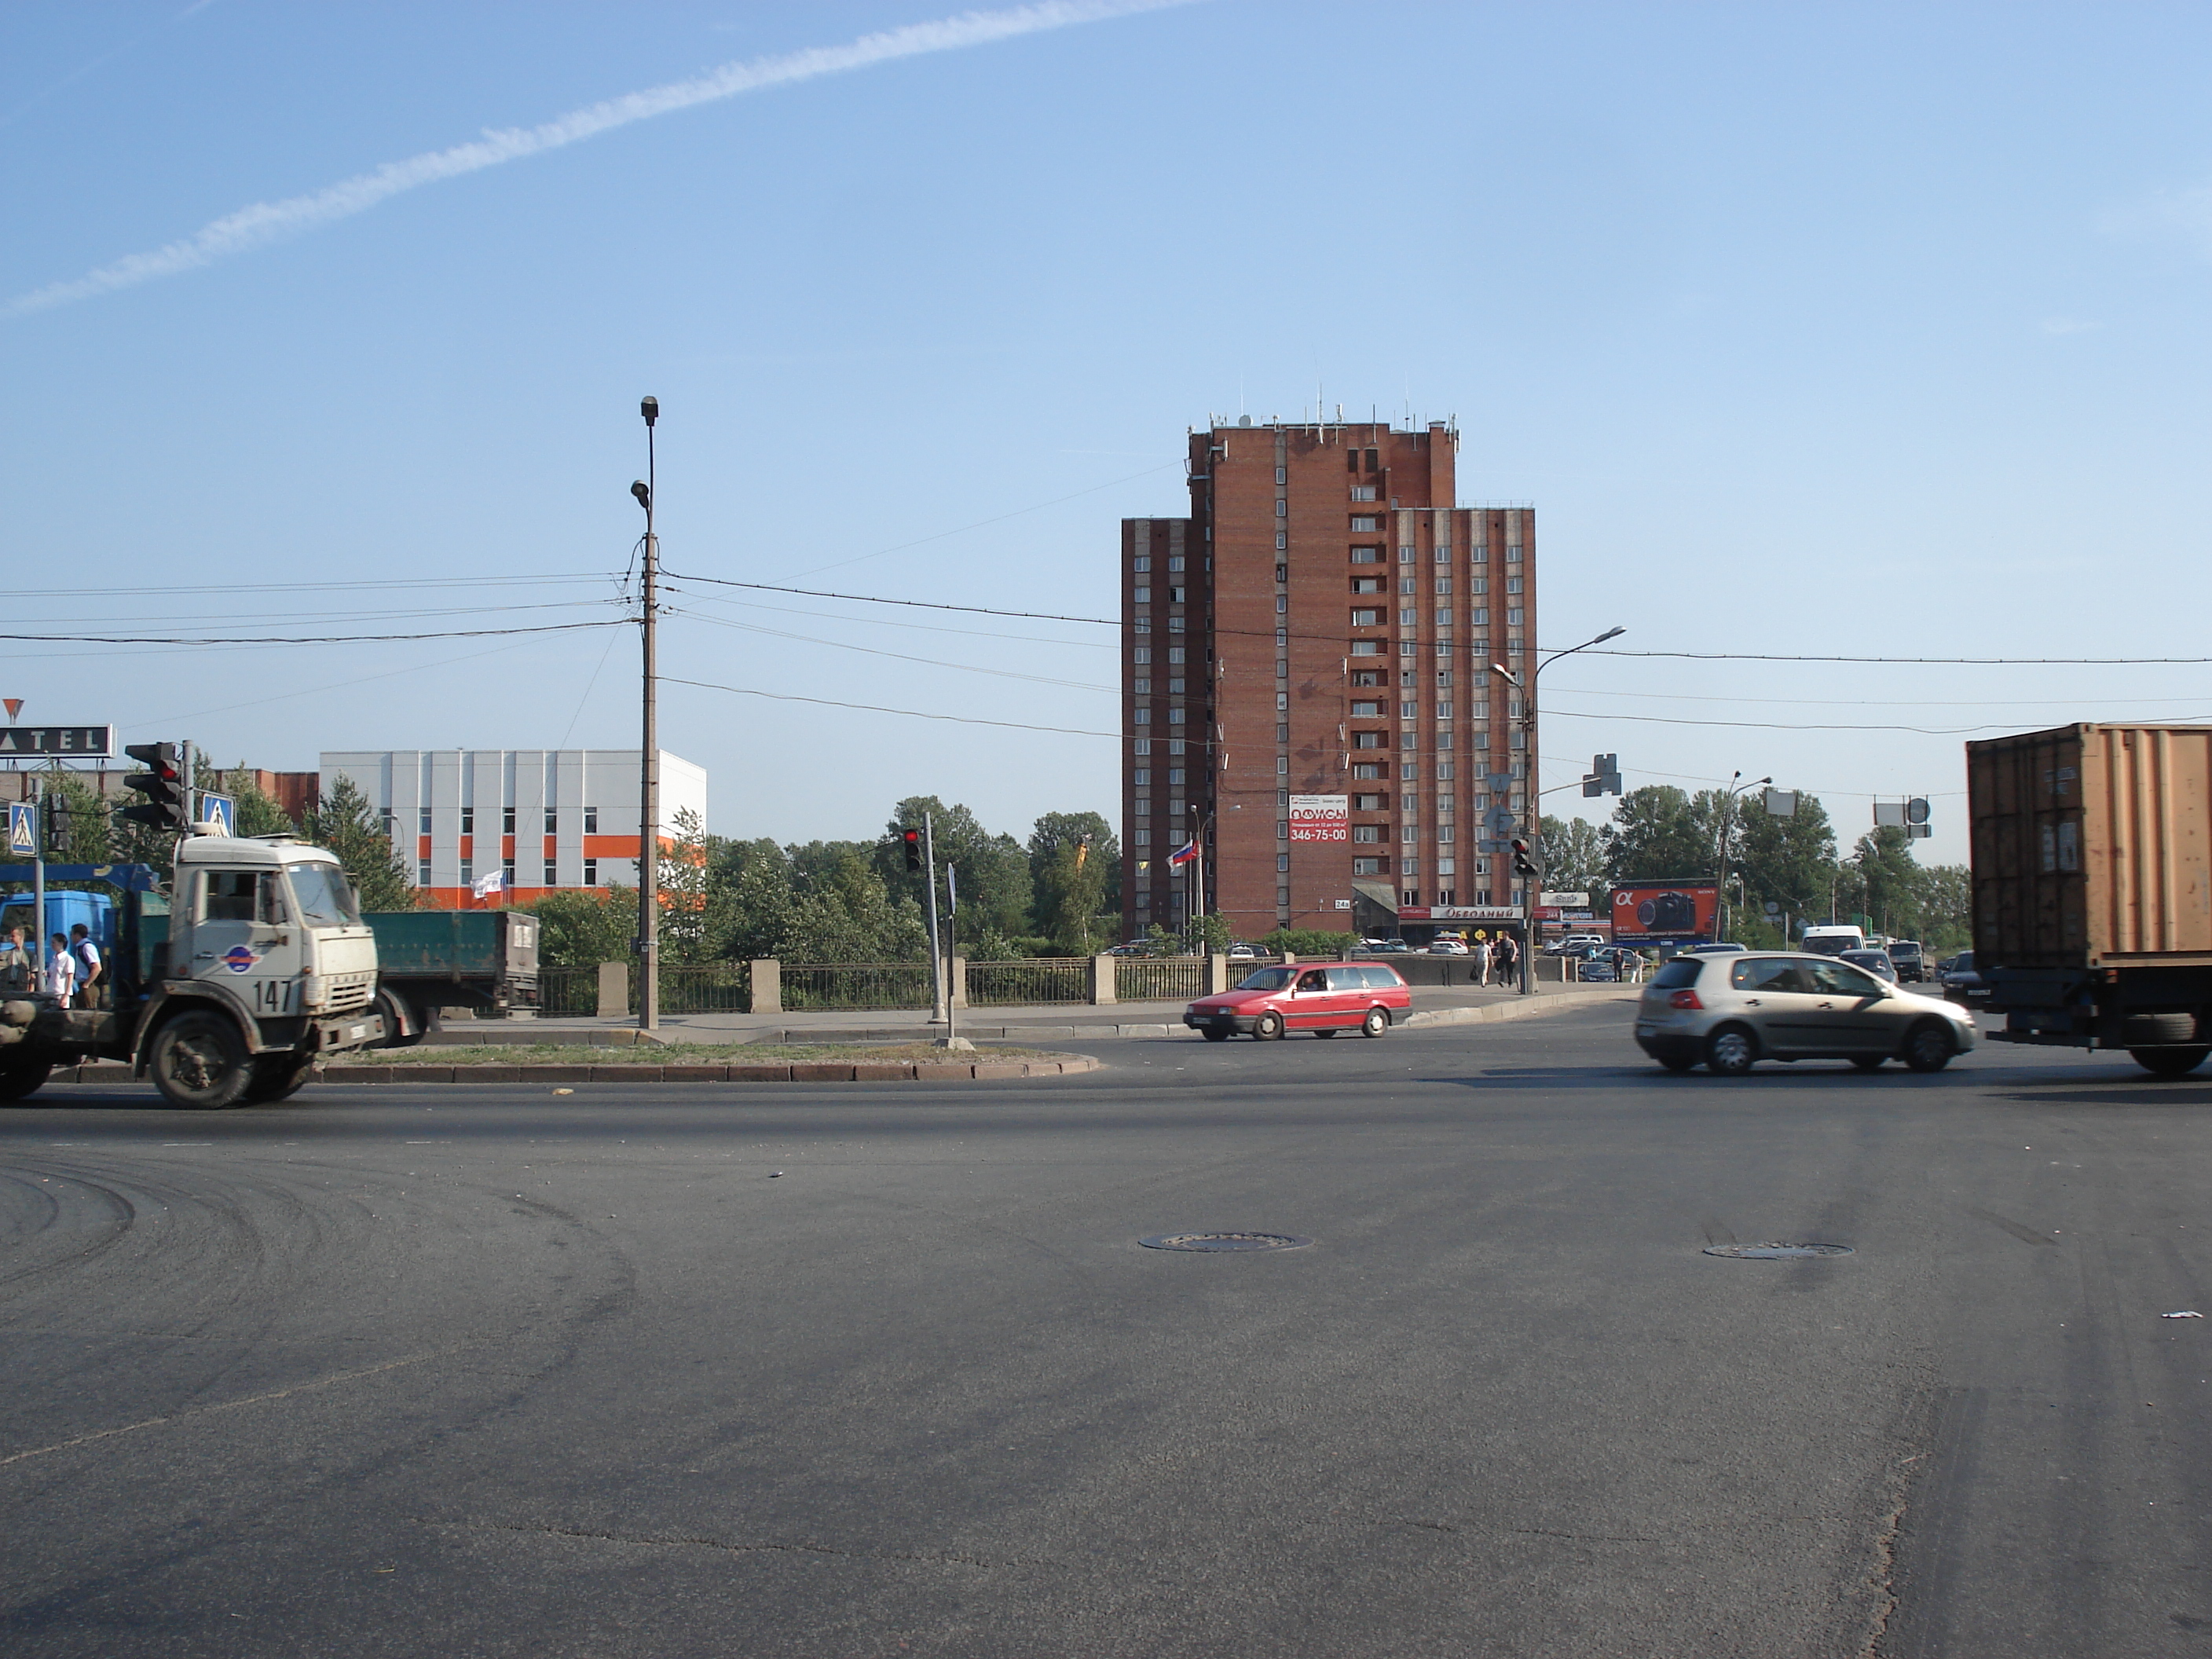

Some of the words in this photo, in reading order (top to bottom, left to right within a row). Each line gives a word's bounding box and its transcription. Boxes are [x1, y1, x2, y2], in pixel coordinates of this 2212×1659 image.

[1291, 809, 1346, 820] ОФИСЫ
[1291, 829, 1346, 840] 346-75-00
[253, 980, 291, 1013] 147
